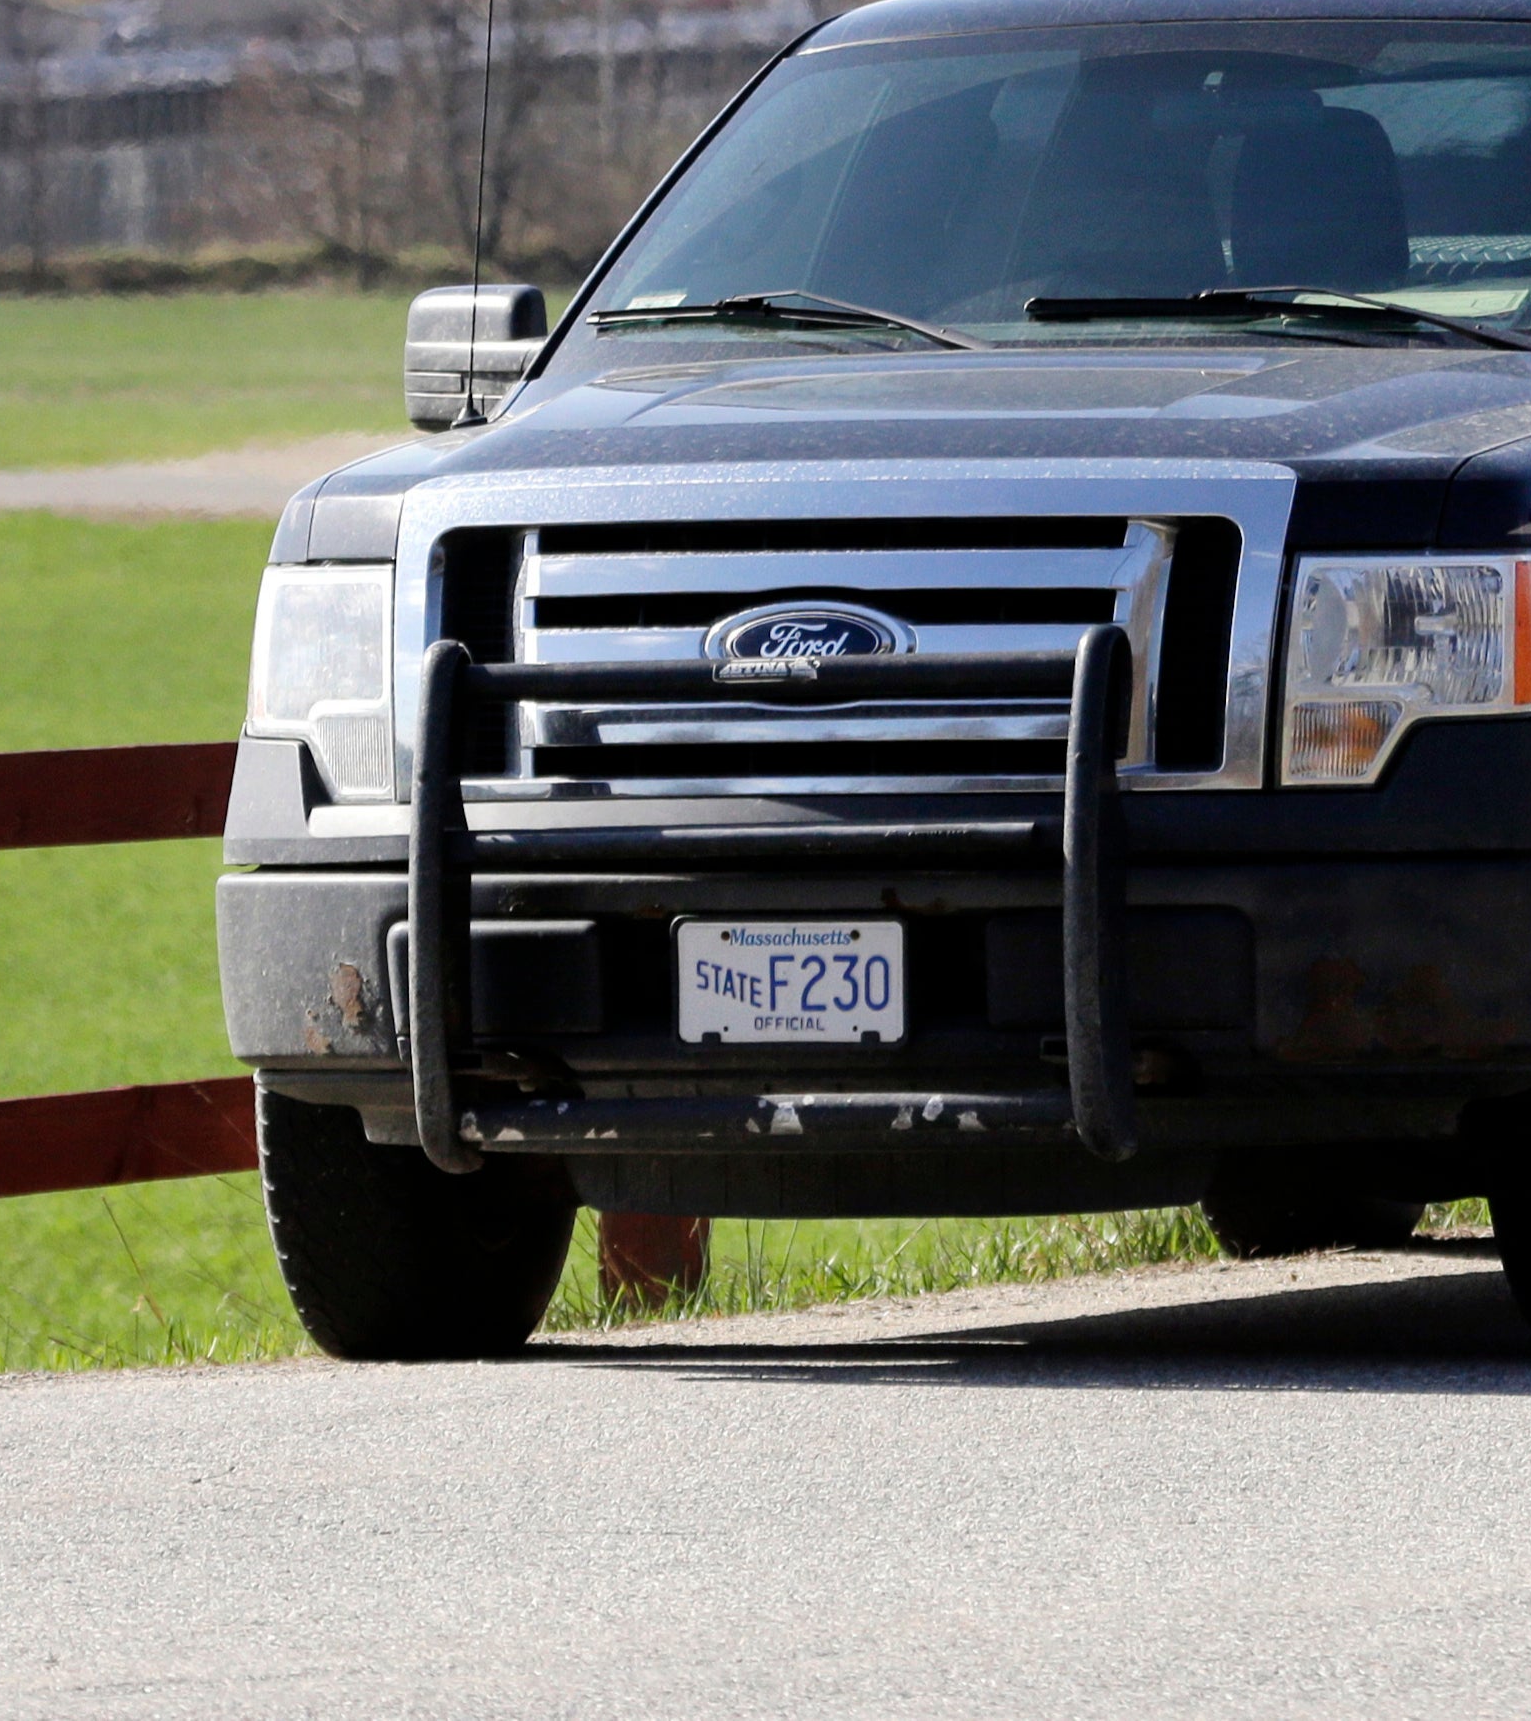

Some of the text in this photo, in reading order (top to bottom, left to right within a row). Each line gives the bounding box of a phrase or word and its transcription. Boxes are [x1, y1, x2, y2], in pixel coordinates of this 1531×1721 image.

[760, 622, 849, 658] Ford
[729, 928, 851, 947] Massachusetts
[696, 954, 890, 1012] STATE F230
[754, 1016, 825, 1031] OFFICIAL
